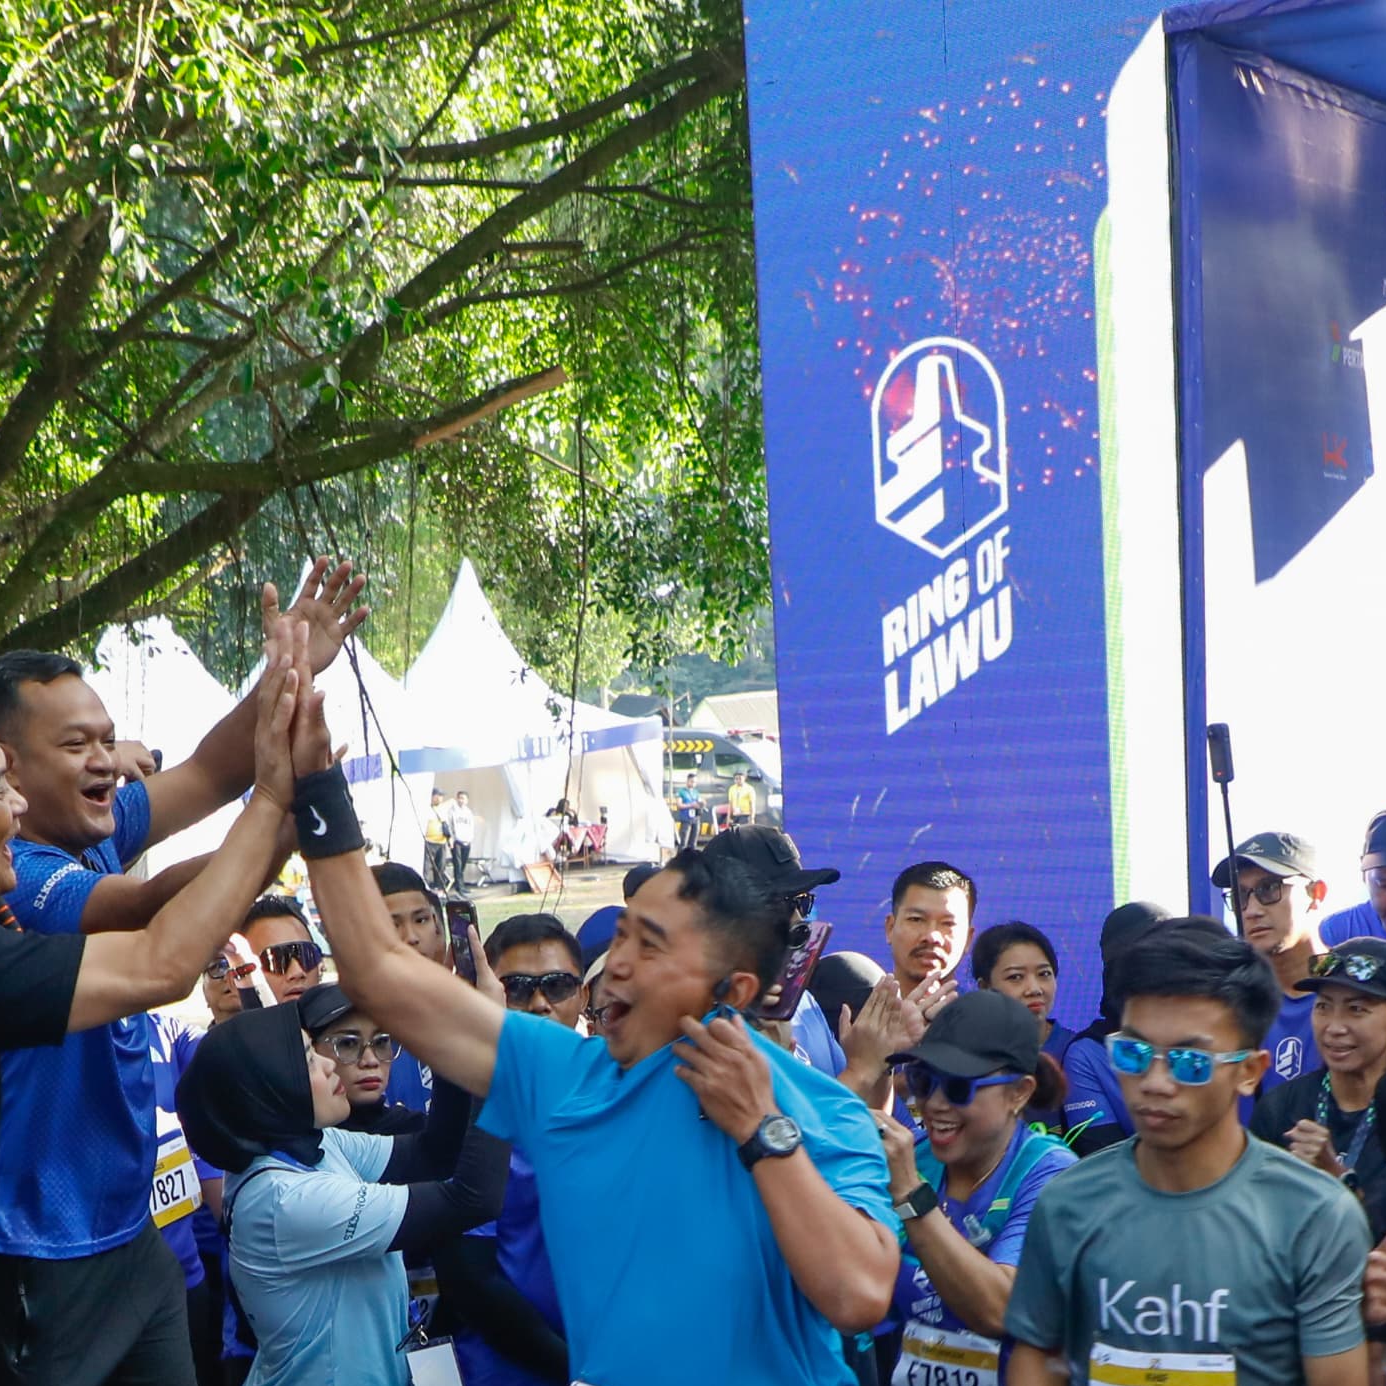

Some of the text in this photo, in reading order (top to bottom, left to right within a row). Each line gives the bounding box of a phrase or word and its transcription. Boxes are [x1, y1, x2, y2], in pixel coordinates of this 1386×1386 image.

[882, 525, 1010, 667] RING OF
[884, 585, 1013, 736] LAWU
[1099, 1278, 1230, 1343] Kahf
